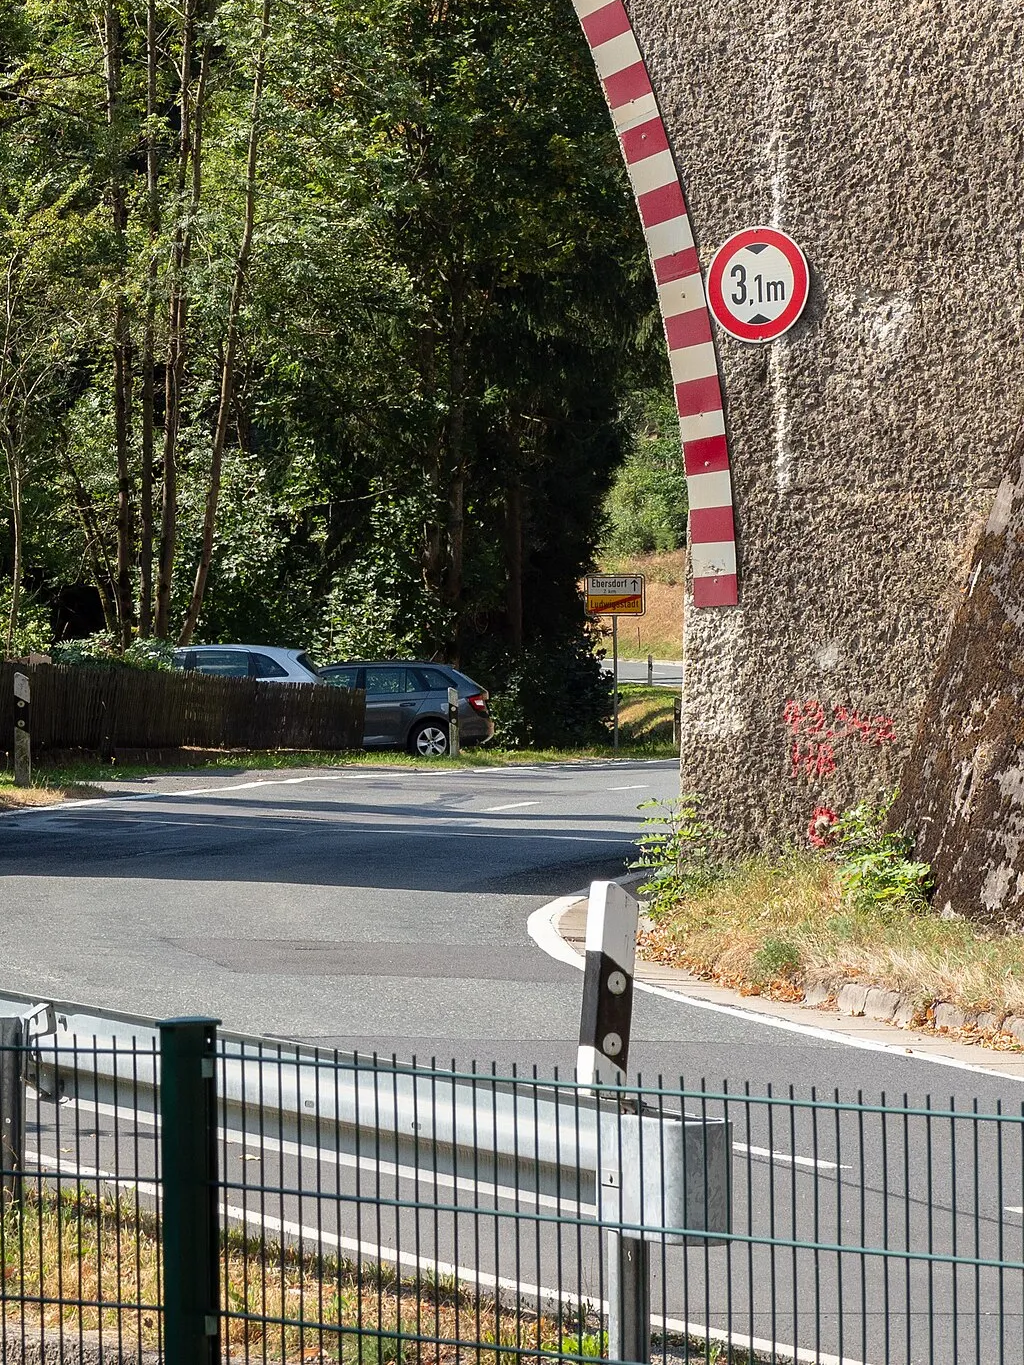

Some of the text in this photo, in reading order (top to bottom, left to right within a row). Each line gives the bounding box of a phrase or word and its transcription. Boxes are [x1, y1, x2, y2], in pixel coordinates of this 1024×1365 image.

[730, 264, 785, 306] 3,1m
[592, 578, 627, 588] Ebersdorf
[591, 599, 639, 610] Ludwigsstadt
